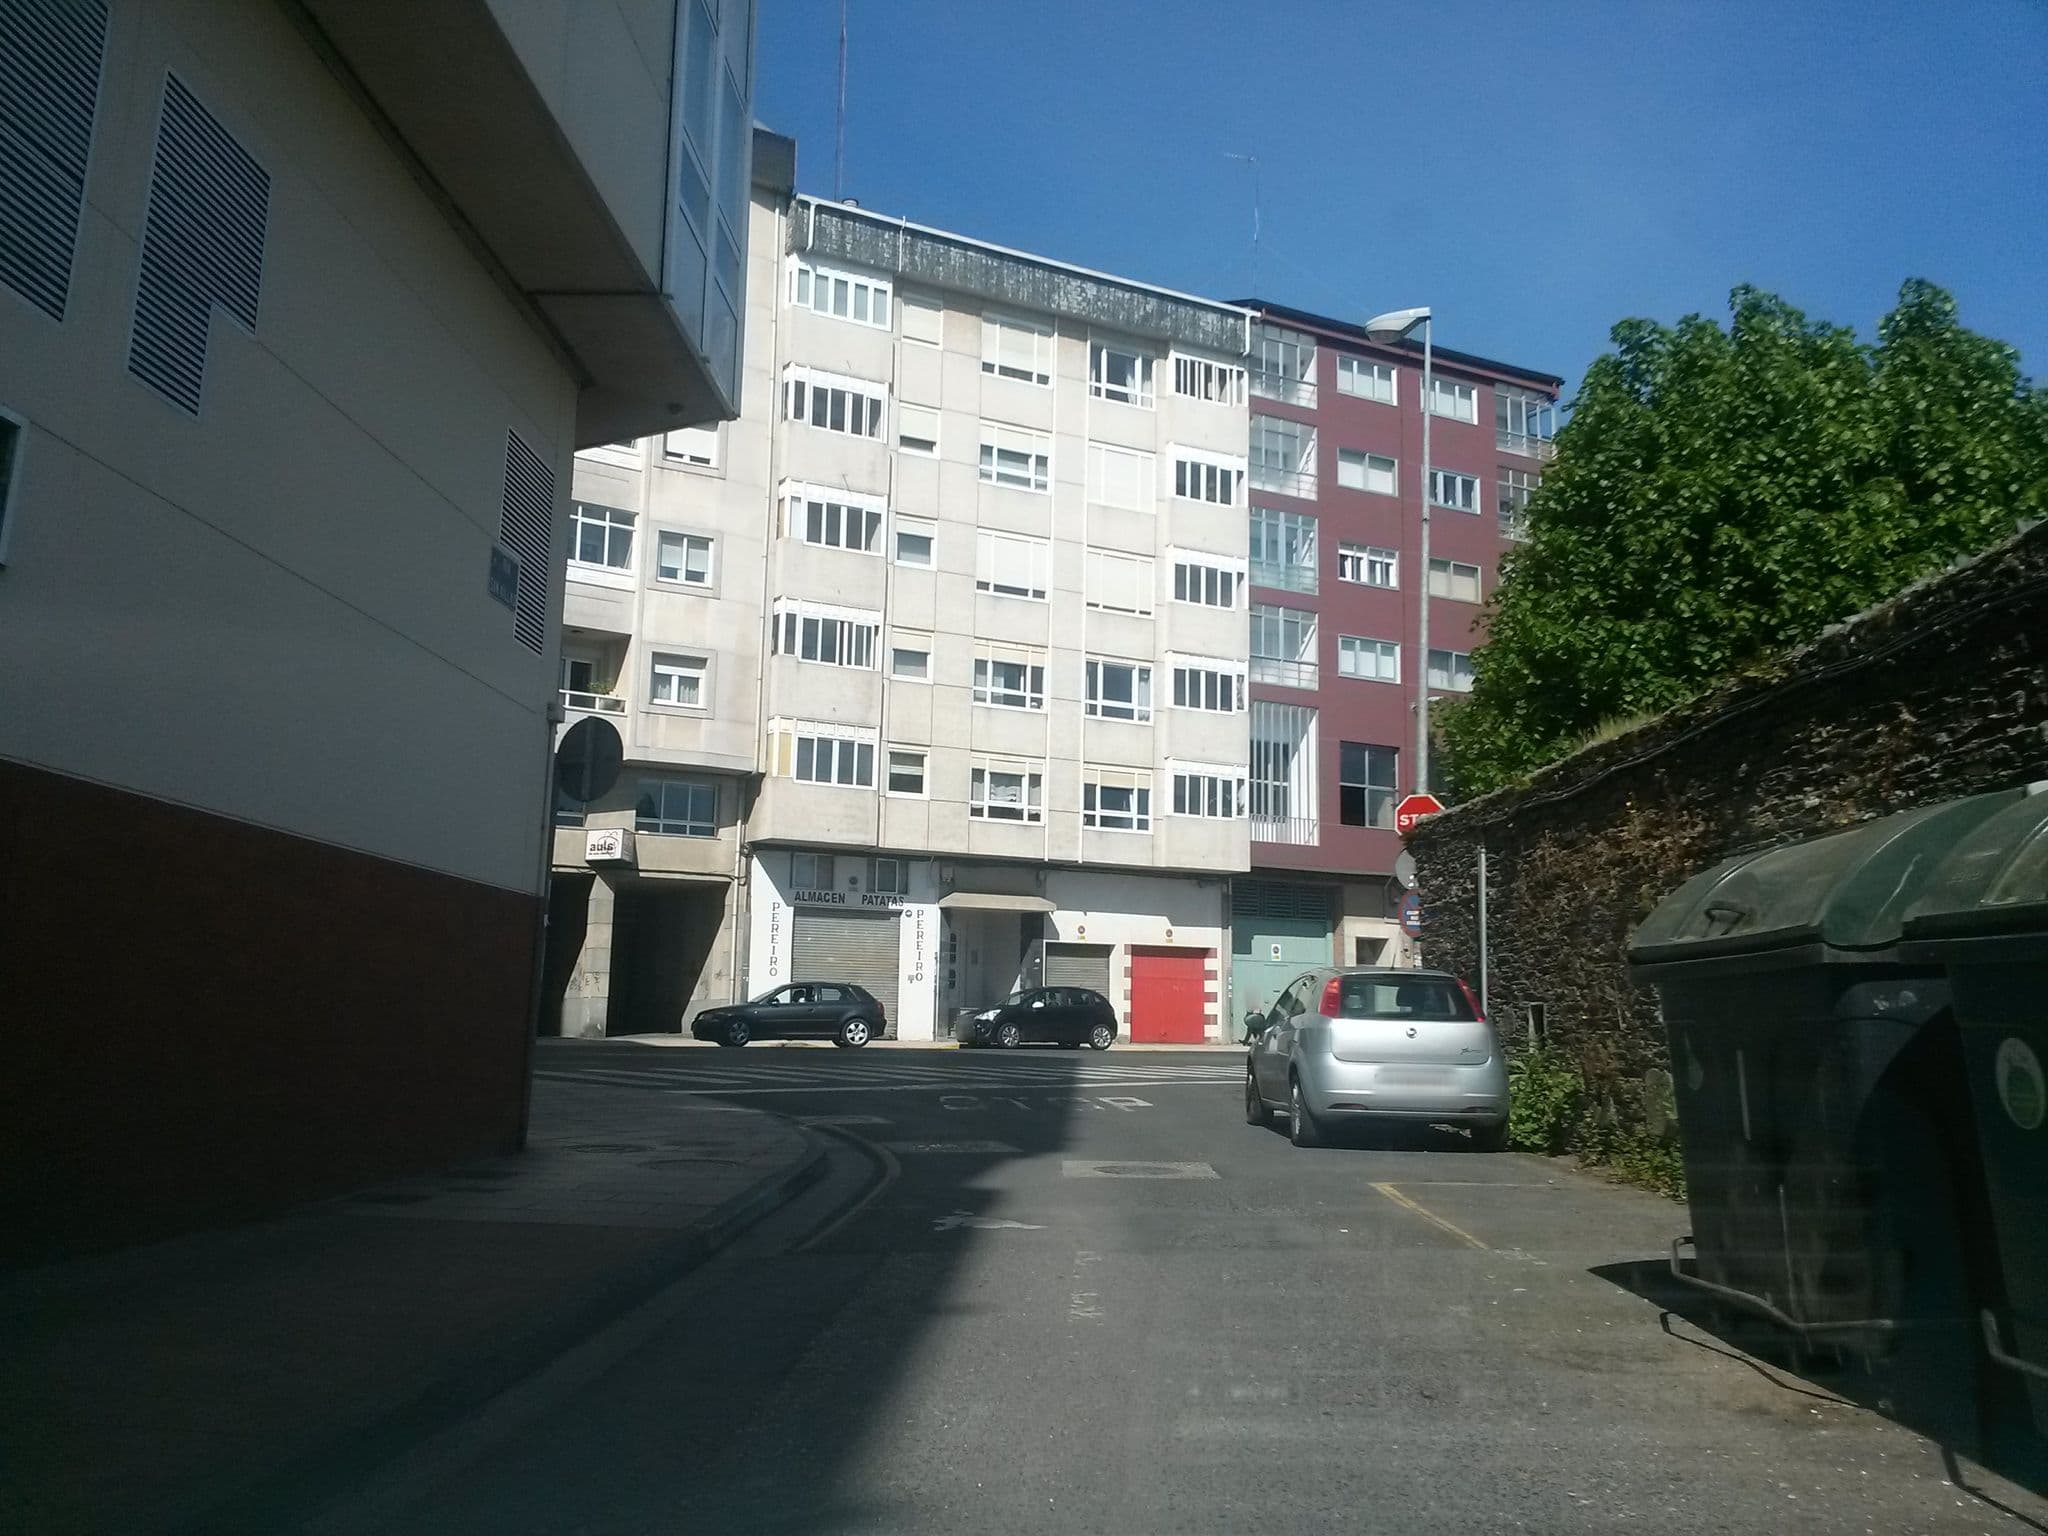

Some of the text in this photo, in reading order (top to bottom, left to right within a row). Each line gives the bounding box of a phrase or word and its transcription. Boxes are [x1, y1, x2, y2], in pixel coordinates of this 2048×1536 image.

[794, 890, 904, 907] ALMACEN PATATAS
[769, 902, 781, 977] PEREIRO
[915, 909, 925, 982] PEREIRO
